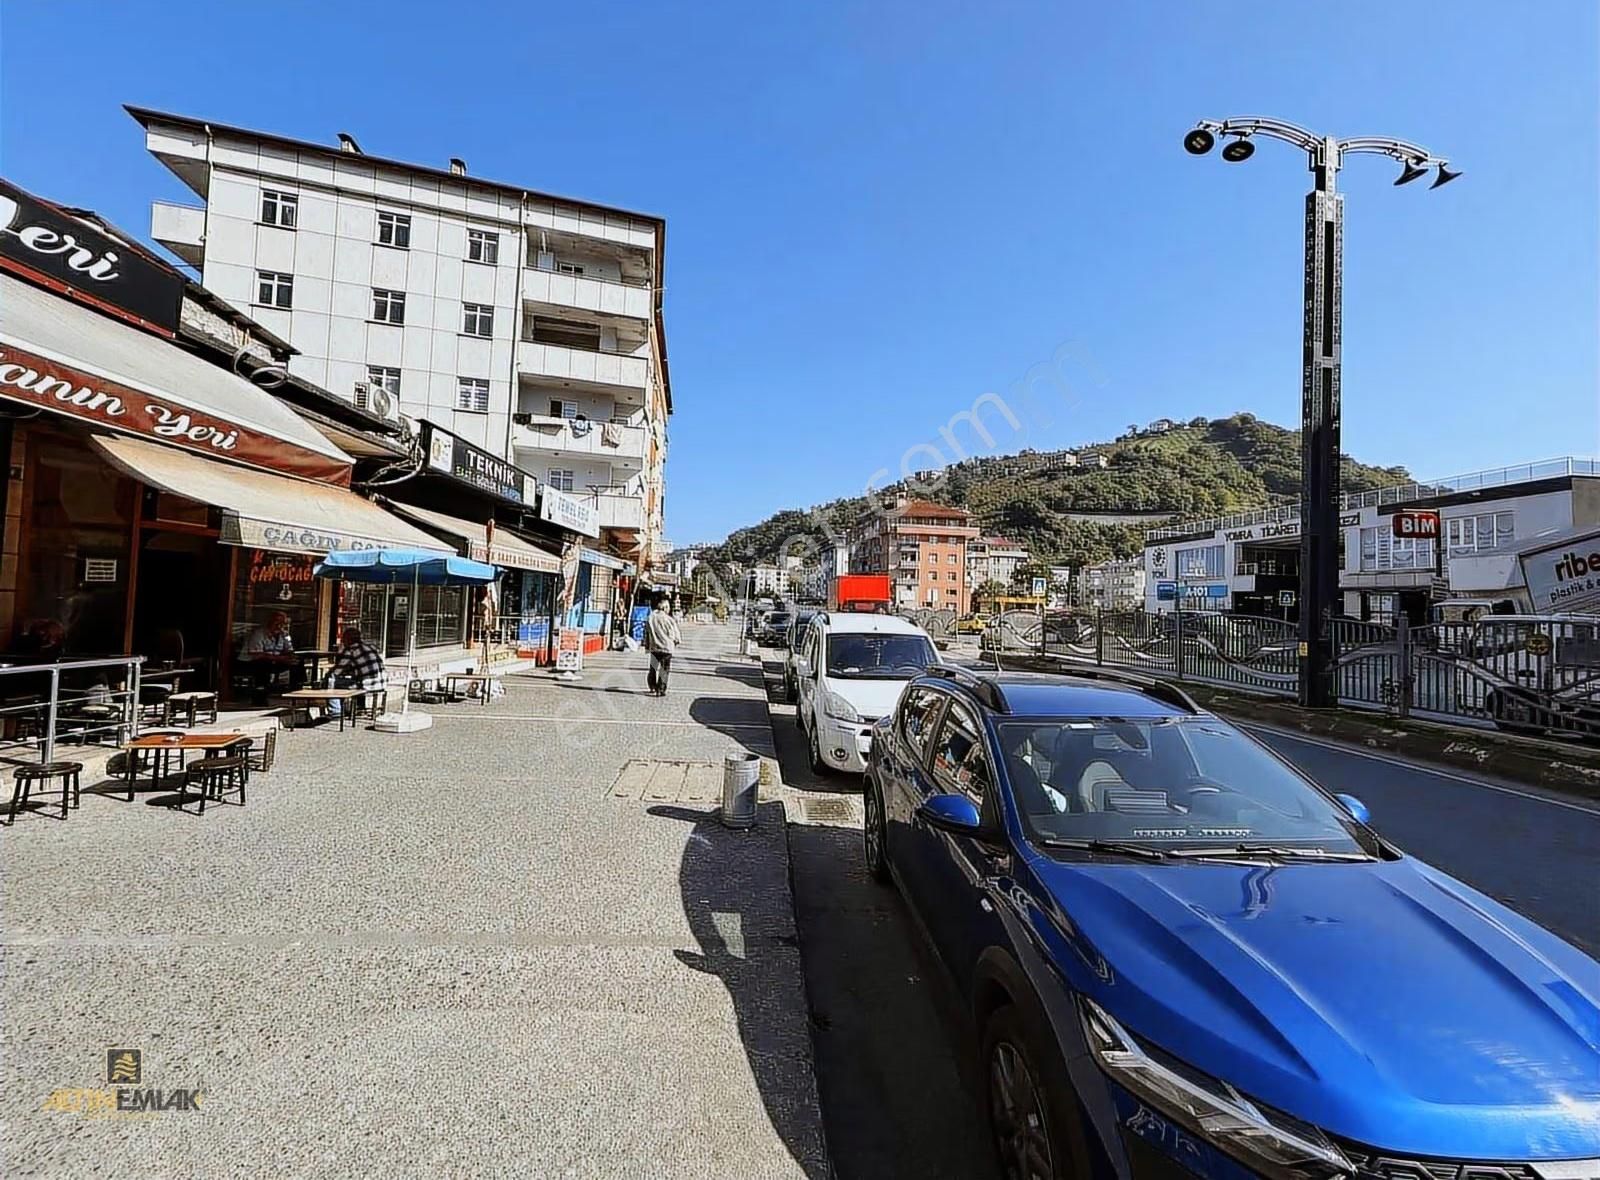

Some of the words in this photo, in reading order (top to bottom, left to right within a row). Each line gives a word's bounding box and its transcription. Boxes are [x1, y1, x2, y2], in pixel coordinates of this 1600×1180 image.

[0, 353, 127, 416] anın
[145, 403, 239, 450] Yeri
[466, 449, 515, 486] TEKNİK
[1224, 530, 1254, 542] YOMRA
[1260, 522, 1299, 538] TİCARET
[1401, 514, 1436, 533] BİM
[264, 527, 341, 550] ÇAĞIN
[1550, 582, 1585, 603] plastik
